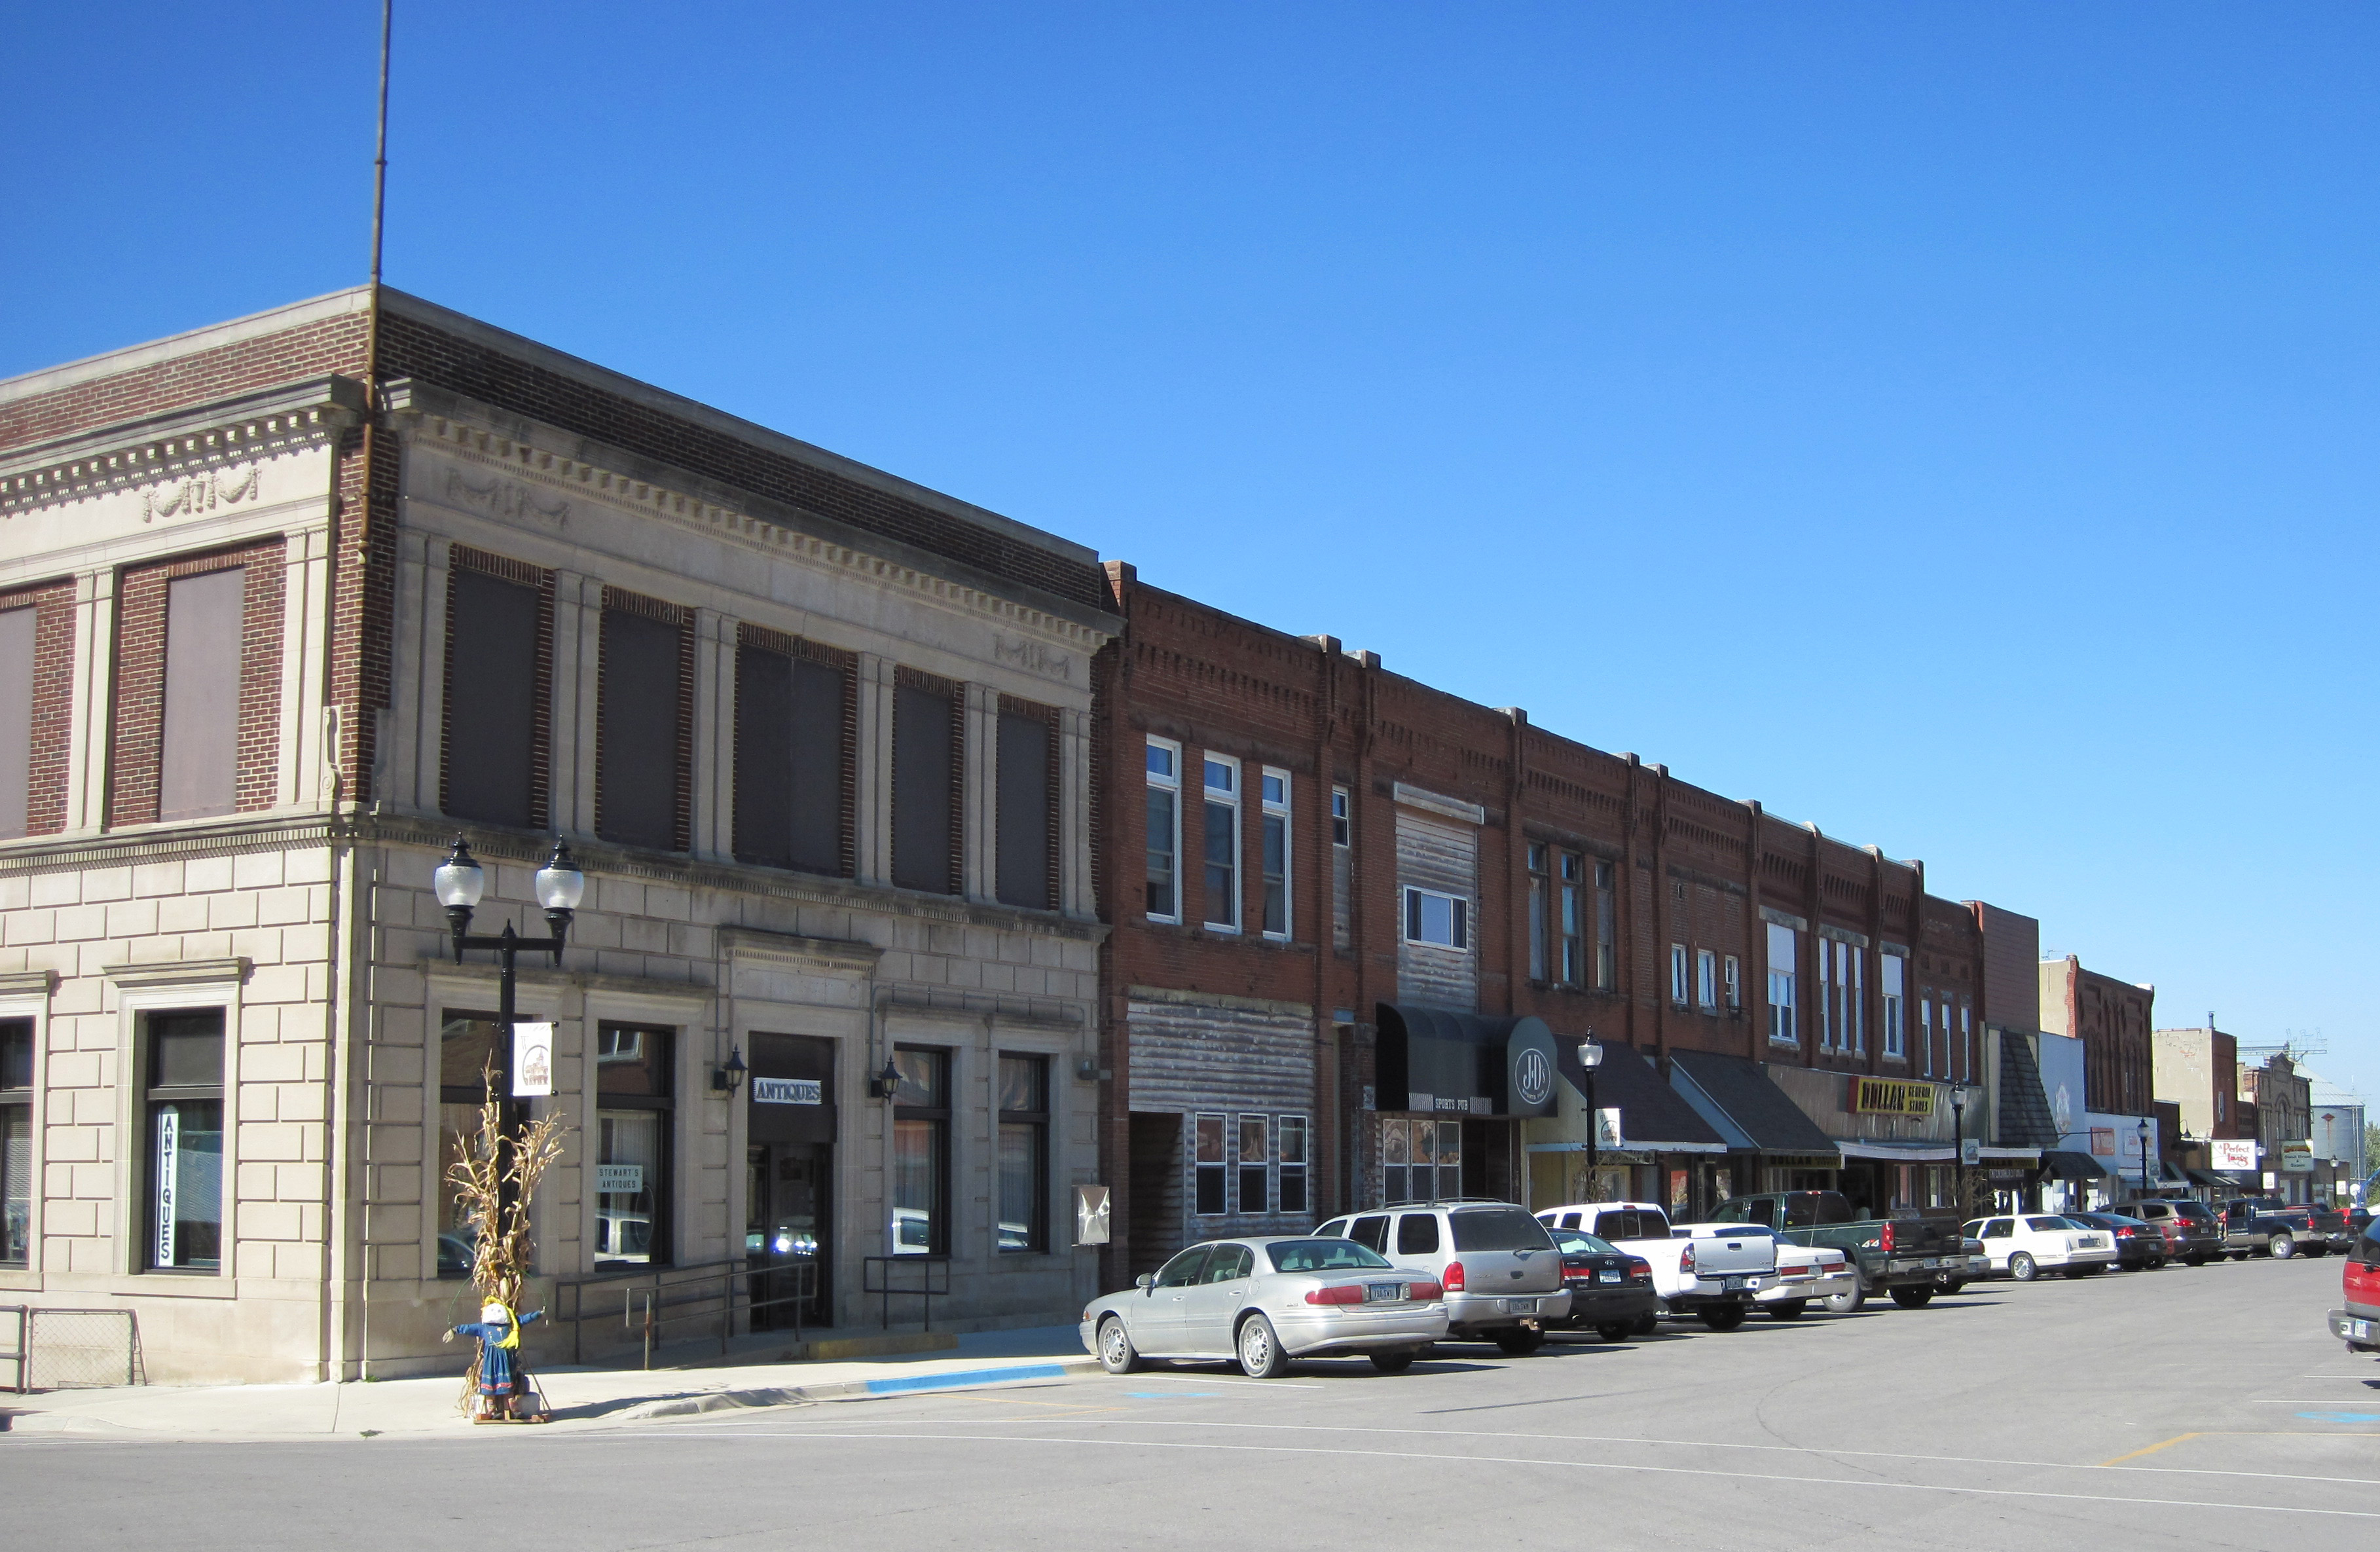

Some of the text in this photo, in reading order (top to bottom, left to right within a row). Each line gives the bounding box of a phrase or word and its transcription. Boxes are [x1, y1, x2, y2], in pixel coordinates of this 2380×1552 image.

[756, 1082, 820, 1101] ANTIQUES
[1862, 1081, 1905, 1111] DOLLAR
[1909, 1086, 1931, 1098] GENERAL
[1435, 1098, 1468, 1110] SPORTS PUB
[1909, 1100, 1928, 1112] STORES
[2223, 1143, 2250, 1155] Perfect
[2227, 1153, 2248, 1167] Image
[161, 1115, 174, 1259] ANTIQUES
